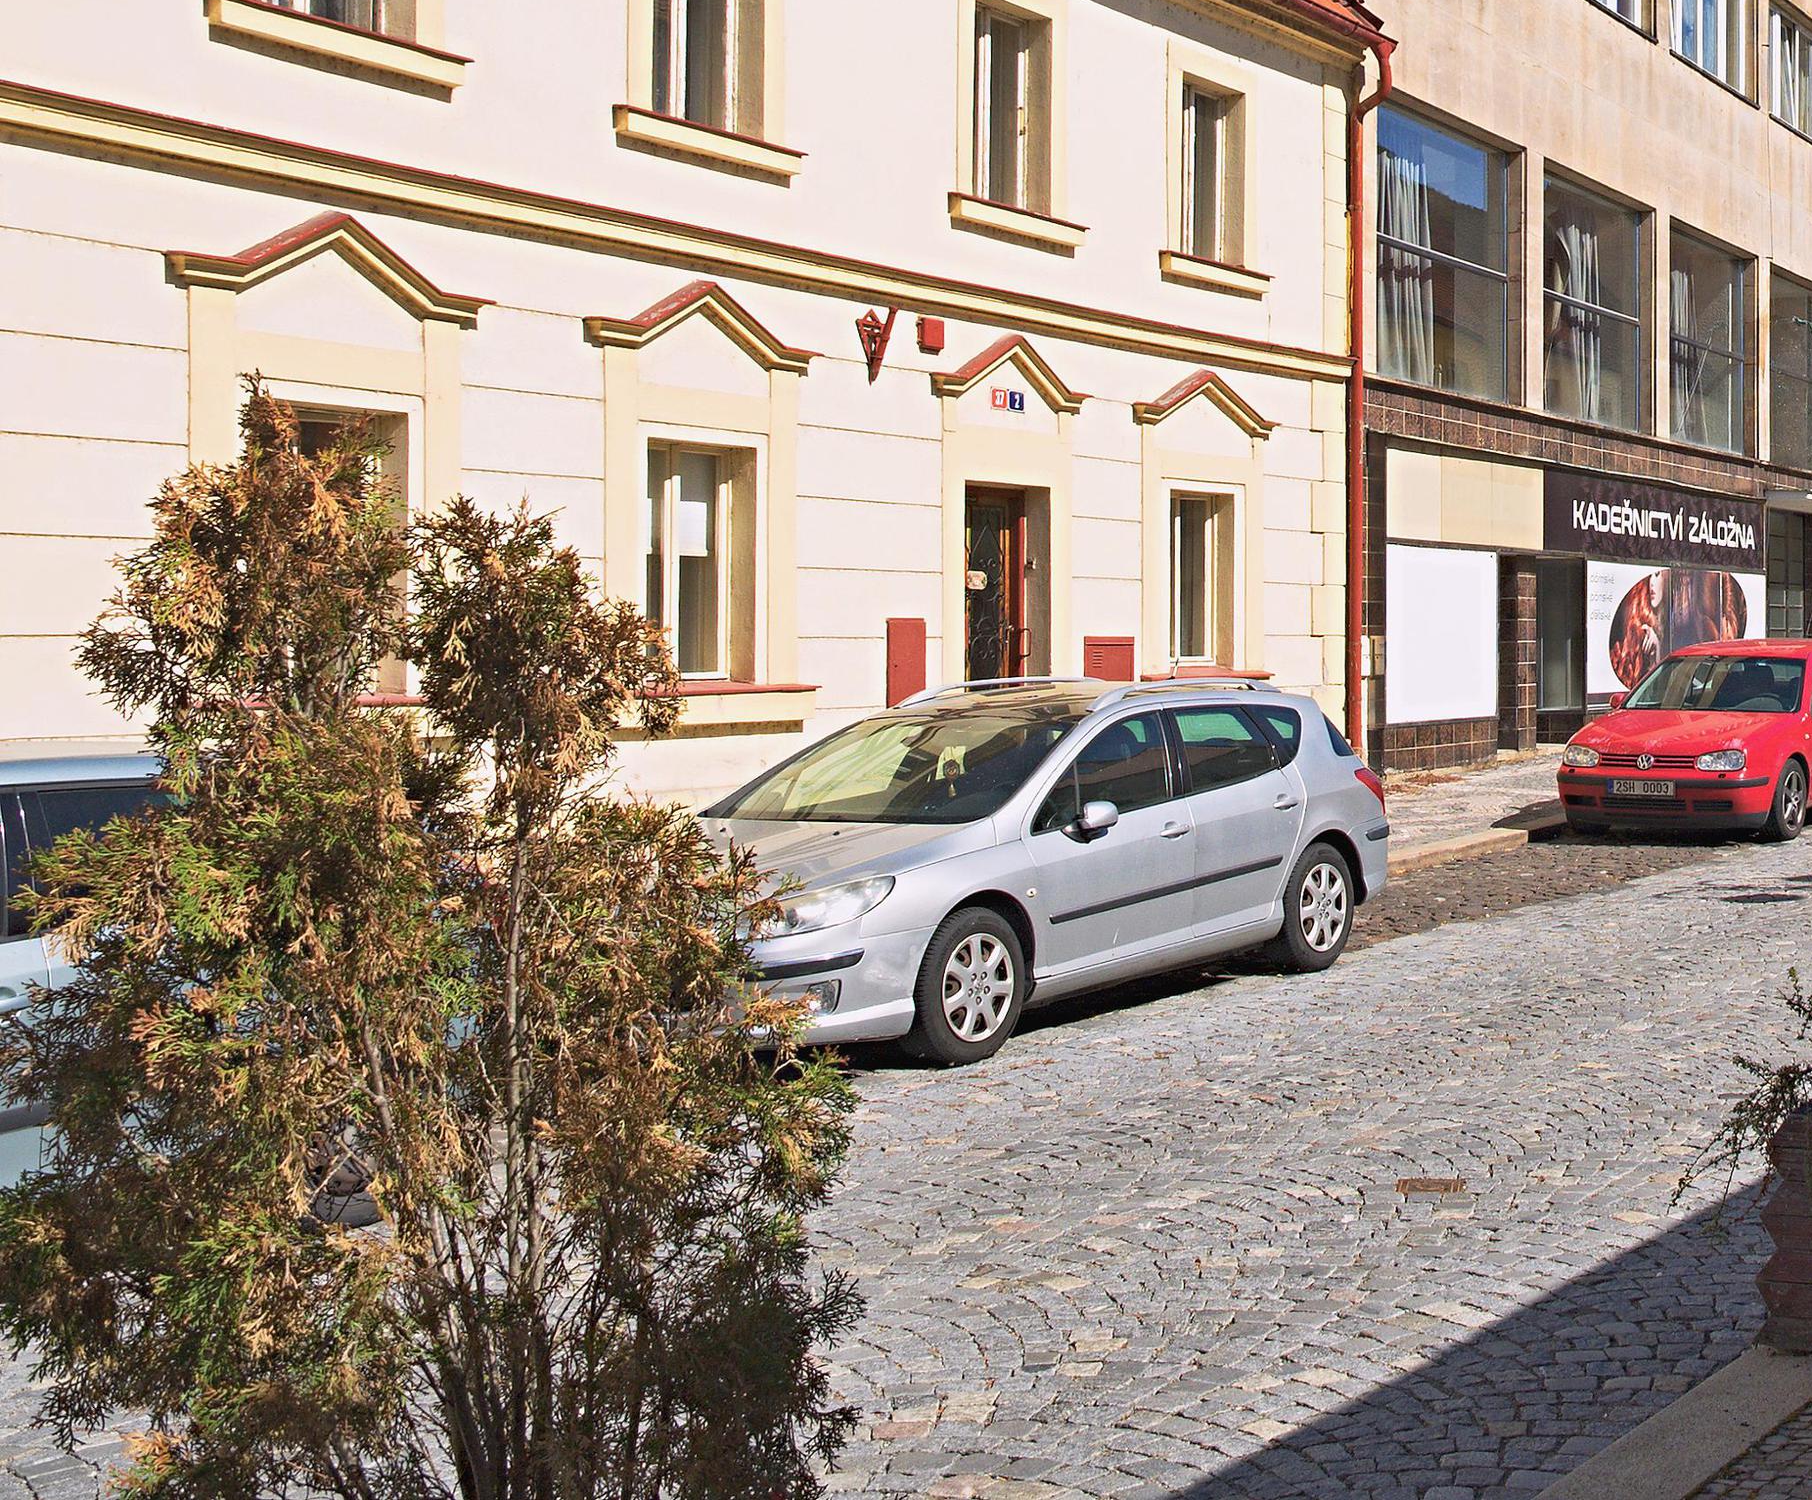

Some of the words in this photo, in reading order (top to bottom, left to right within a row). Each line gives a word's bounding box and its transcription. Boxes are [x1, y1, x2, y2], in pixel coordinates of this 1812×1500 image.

[1014, 393, 1020, 409] 2
[1572, 499, 1684, 542] KADEŘNICTVÍ
[1688, 511, 1756, 551] ZÁLOŽNA
[1616, 781, 1635, 793] 2SH
[1642, 782, 1669, 794] 0003
